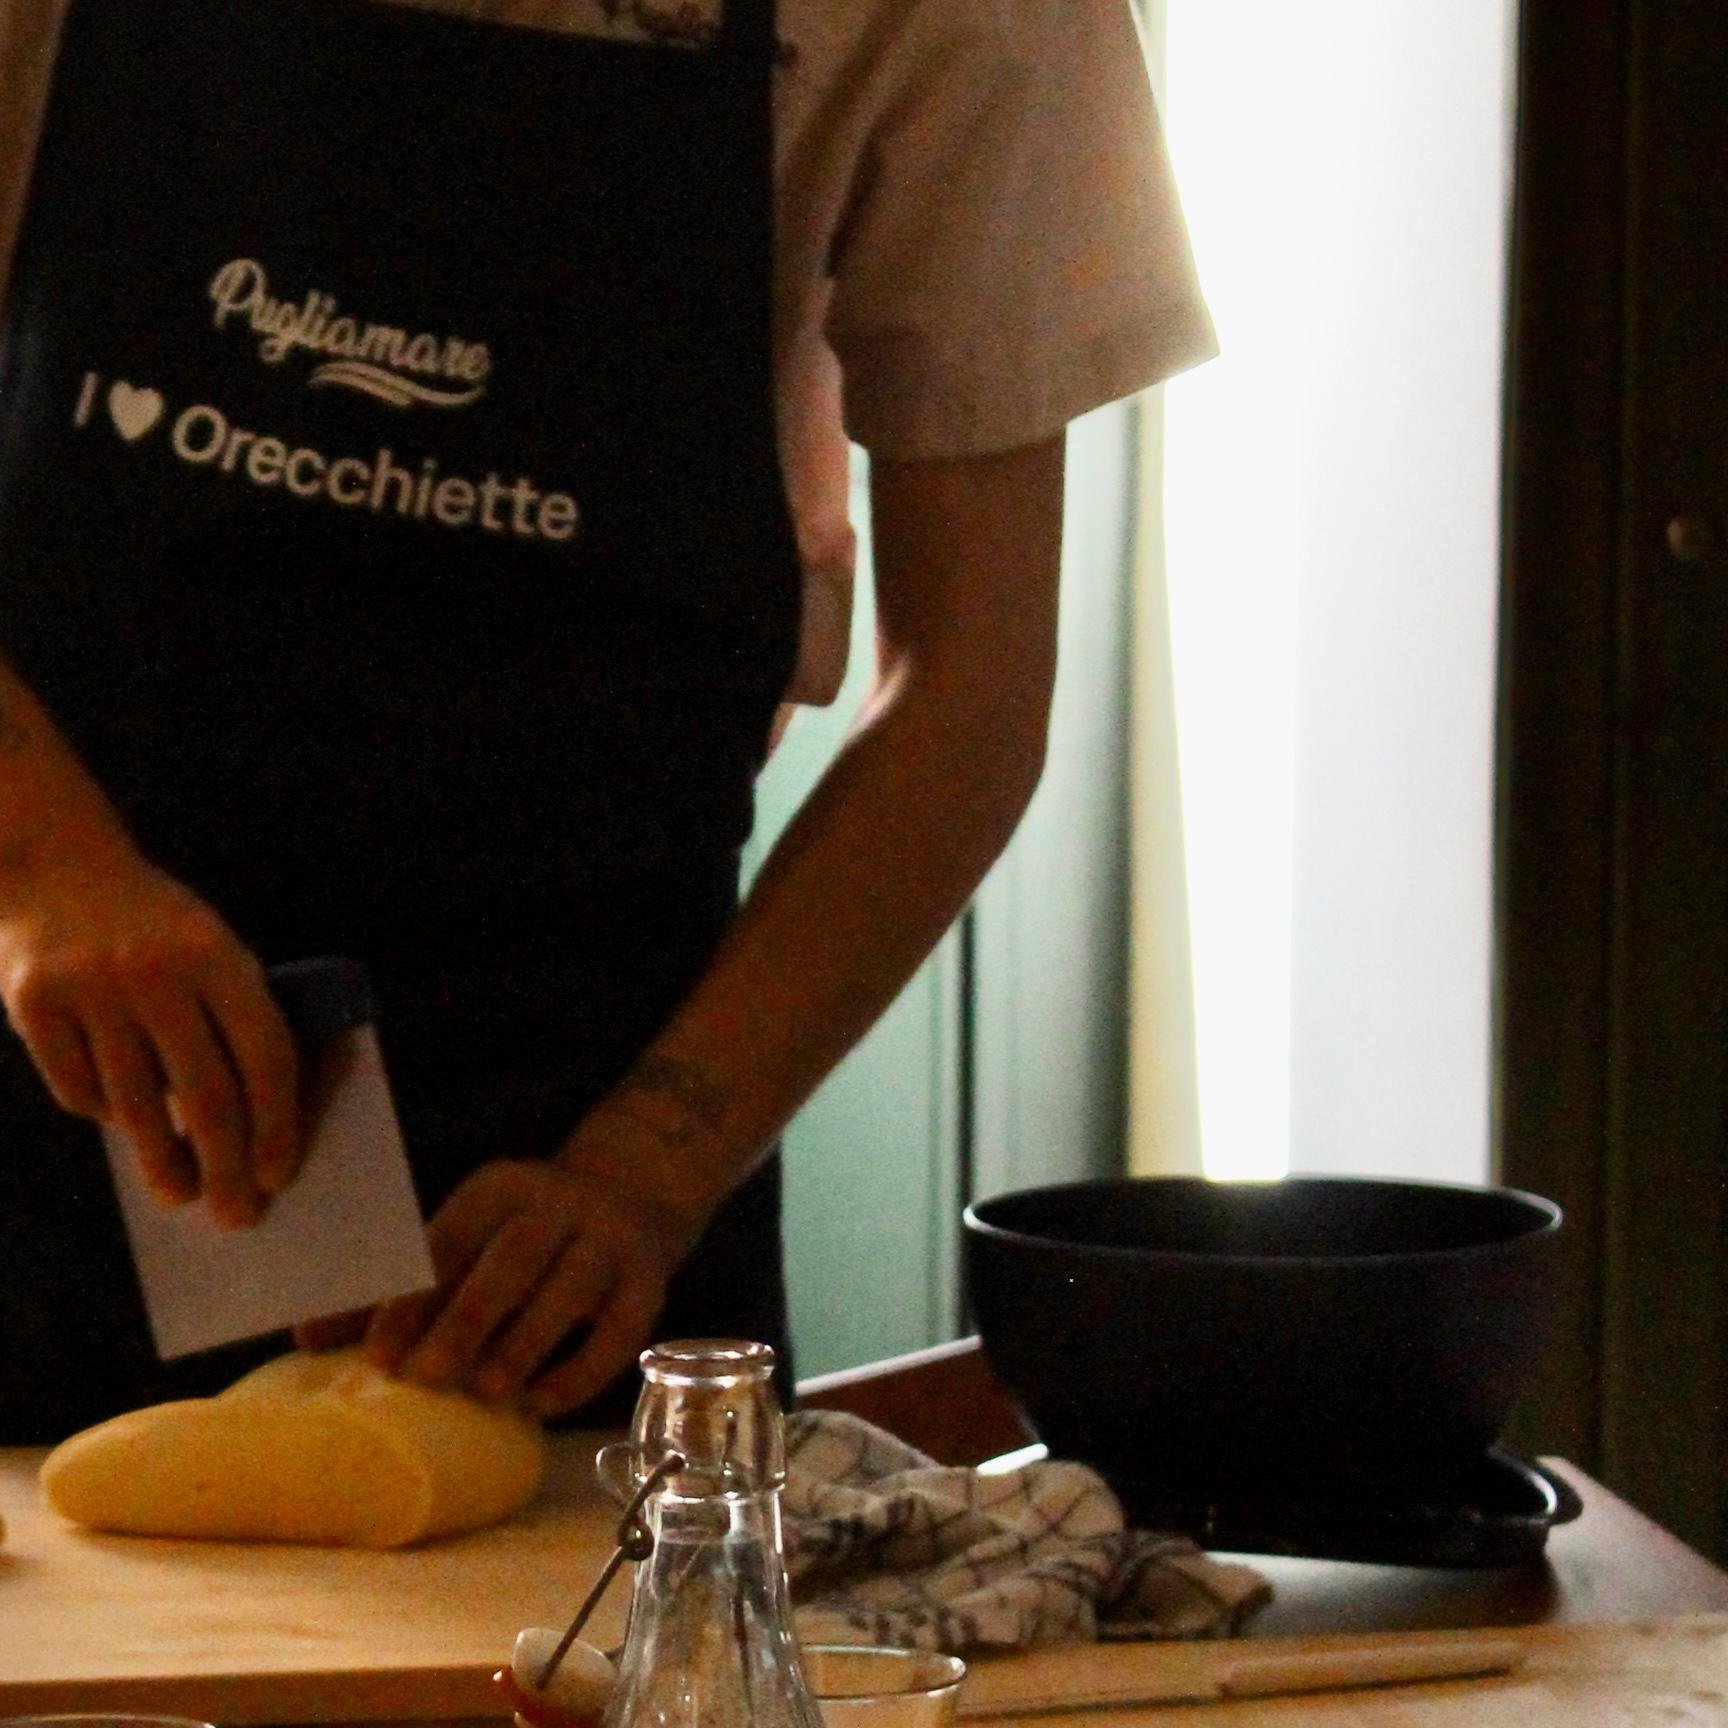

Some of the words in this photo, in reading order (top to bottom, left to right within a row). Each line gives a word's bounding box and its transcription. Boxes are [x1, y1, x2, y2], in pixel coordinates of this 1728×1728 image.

[210, 259, 491, 380] Pugliamare
[75, 373, 96, 427] I
[172, 405, 578, 540] Orecchiette
